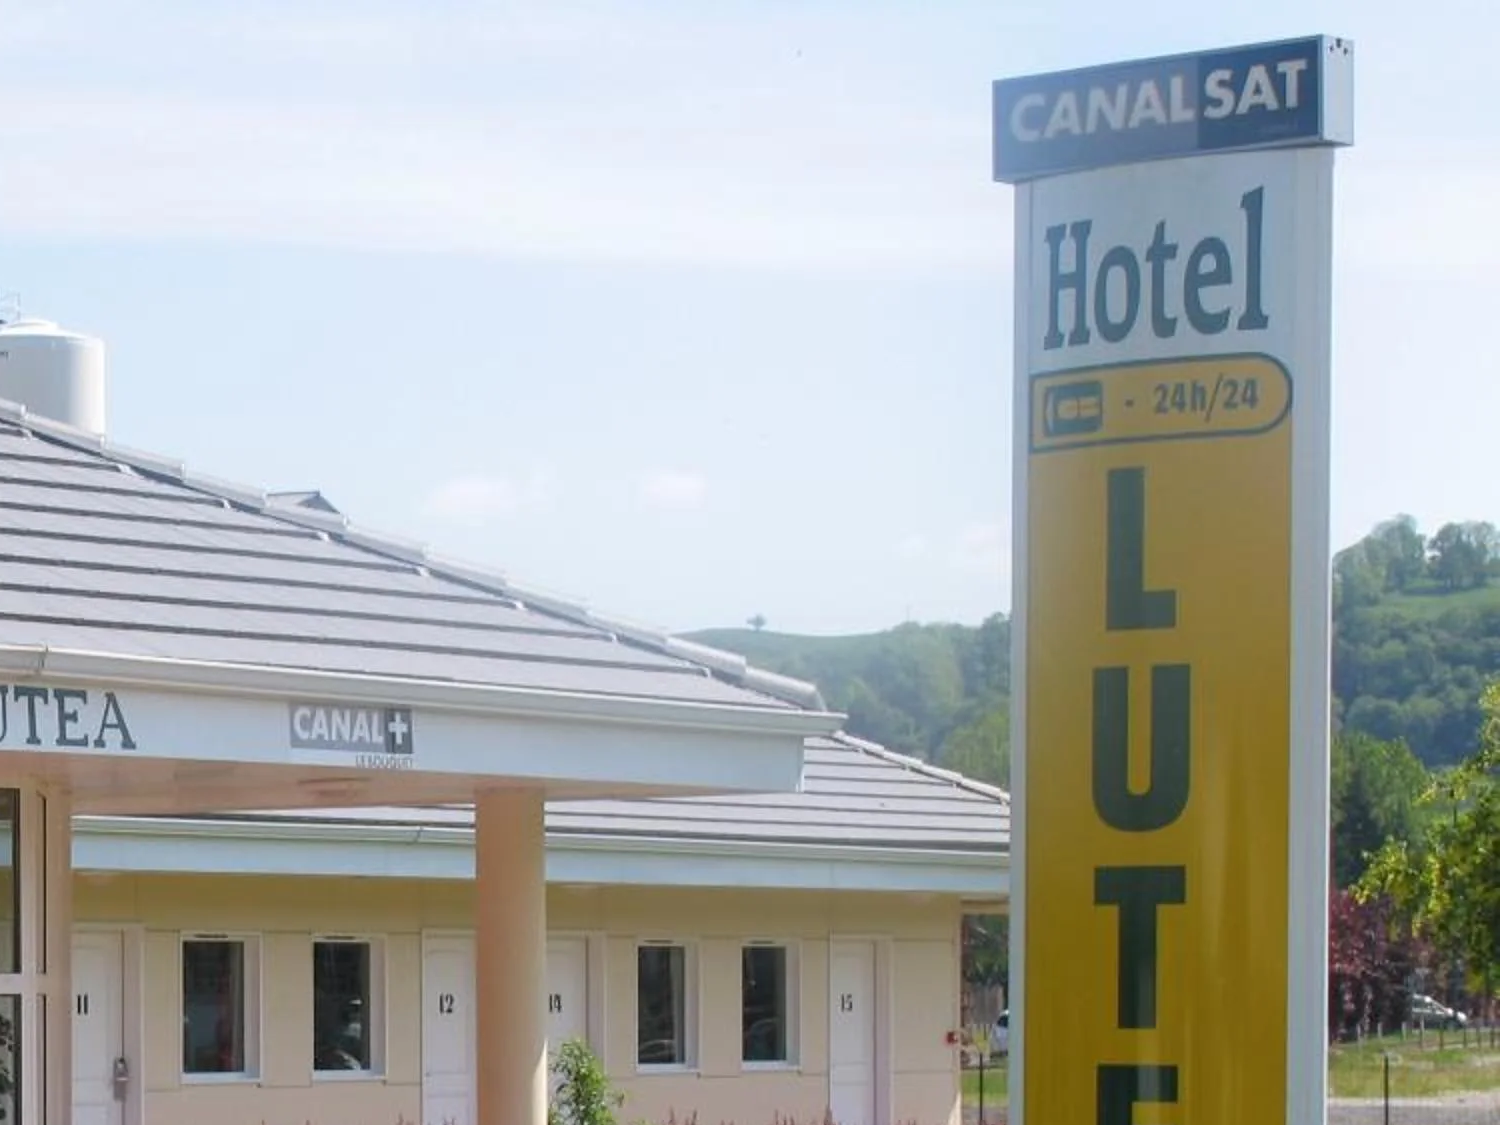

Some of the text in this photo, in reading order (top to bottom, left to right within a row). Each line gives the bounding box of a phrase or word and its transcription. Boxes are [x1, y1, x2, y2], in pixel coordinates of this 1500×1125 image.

[1009, 58, 1307, 143] CANALSAT
[1043, 185, 1269, 351] Hotel
[1153, 373, 1260, 424] 24h/24
[439, 994, 454, 1015] 12
